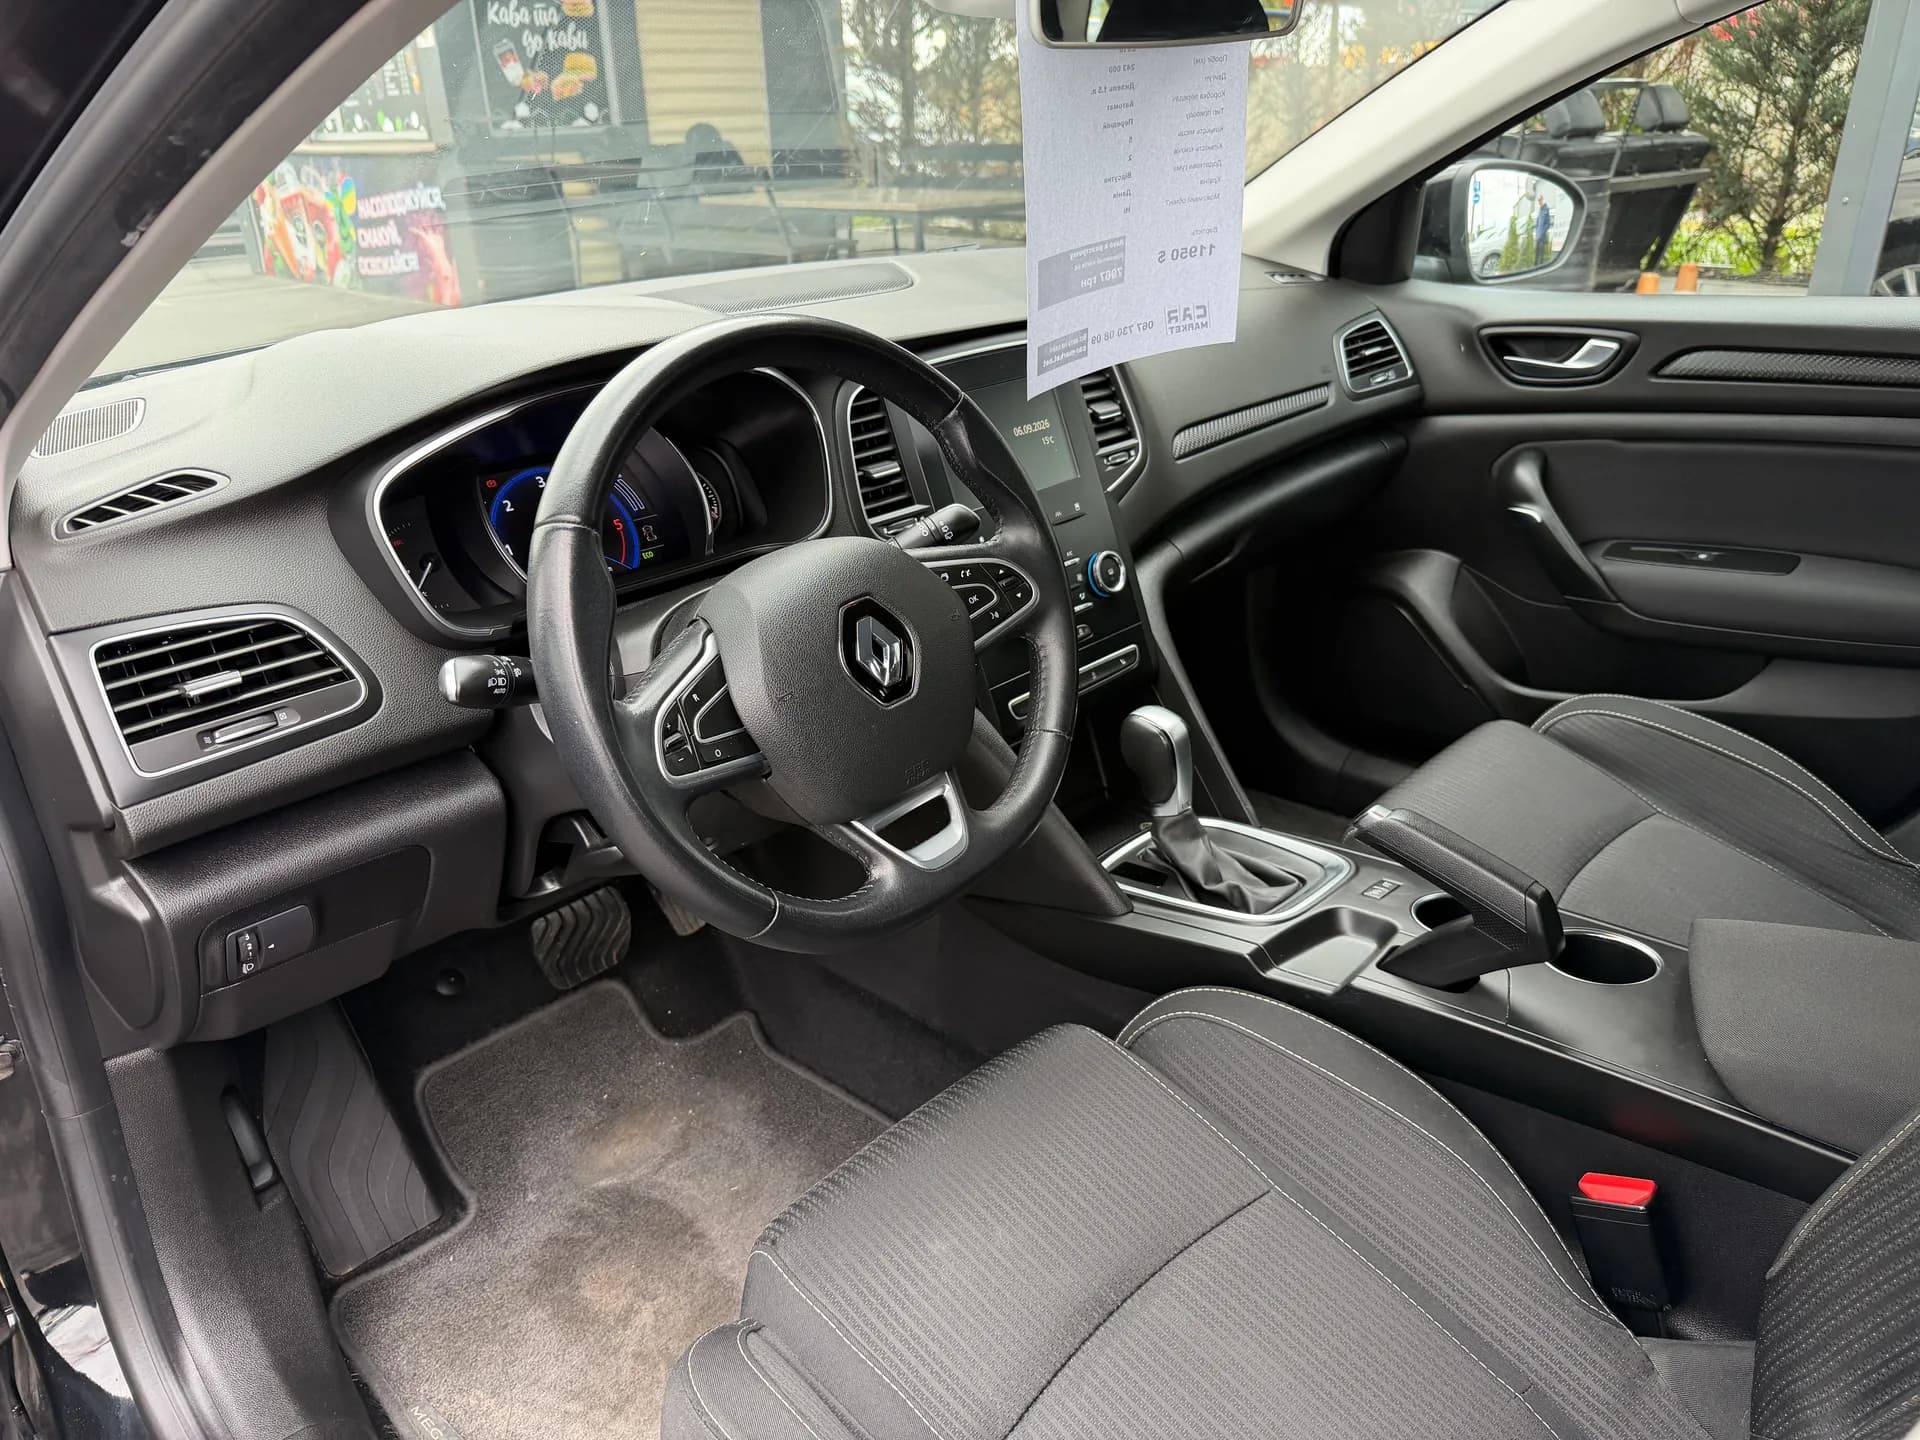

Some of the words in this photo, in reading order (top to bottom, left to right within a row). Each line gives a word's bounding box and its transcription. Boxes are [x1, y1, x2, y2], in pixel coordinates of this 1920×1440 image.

[487, 0, 530, 27] Кава
[522, 29, 543, 58] до
[547, 21, 588, 52] кави
[1013, 419, 1050, 437] 06.09.2026
[535, 476, 545, 488] 3
[502, 499, 514, 513] 2
[613, 518, 623, 531] 5
[641, 550, 654, 560] ECO
[968, 594, 980, 605] OK
[692, 693, 700, 702] R
